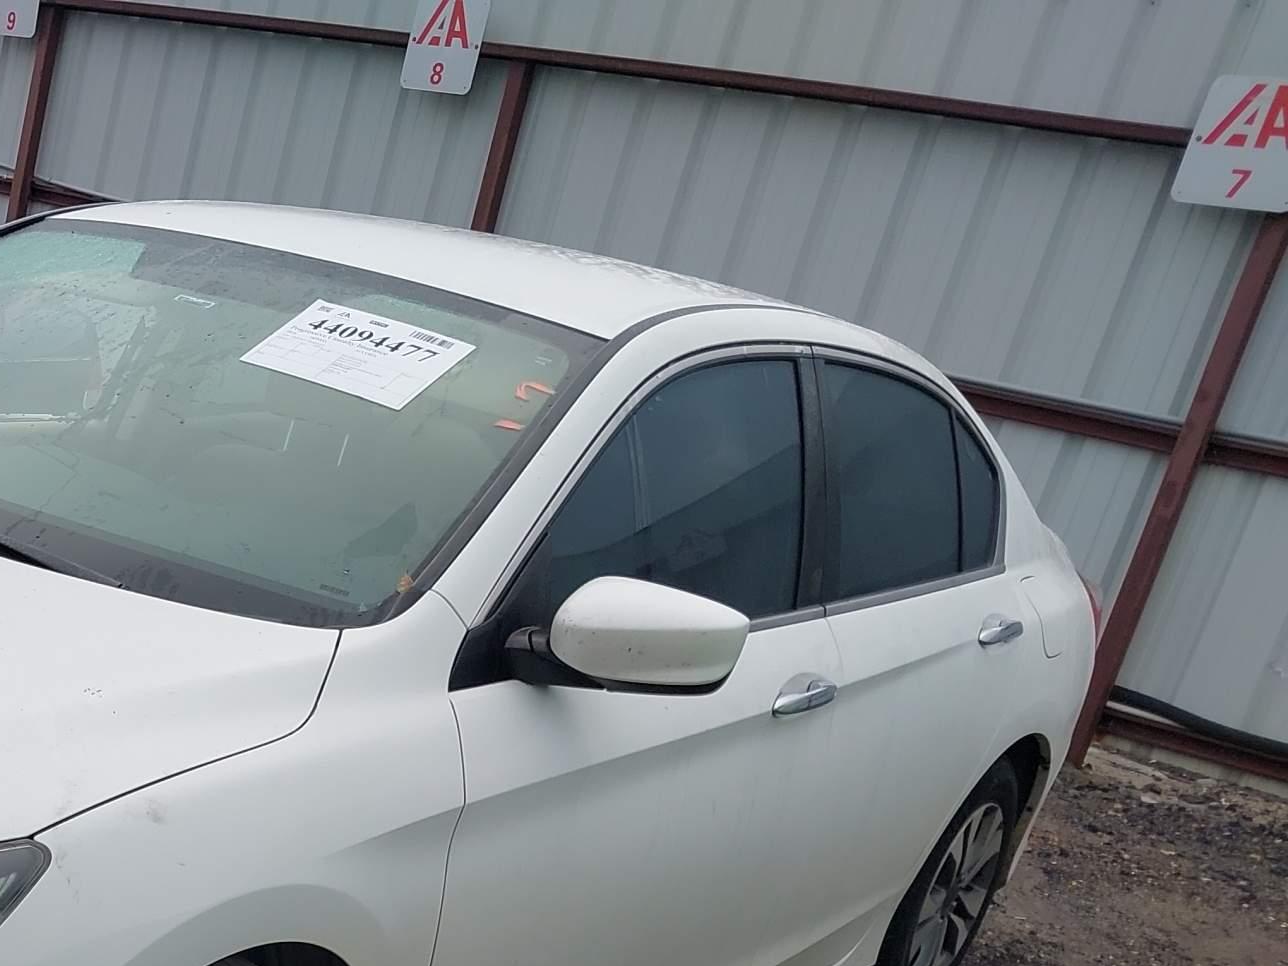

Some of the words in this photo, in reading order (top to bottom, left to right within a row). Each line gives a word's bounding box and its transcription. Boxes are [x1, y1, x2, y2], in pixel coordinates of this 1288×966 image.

[6, 11, 16, 30] 9
[430, 62, 444, 85] 8
[1225, 168, 1252, 198] 7
[308, 318, 440, 362] 44094477
